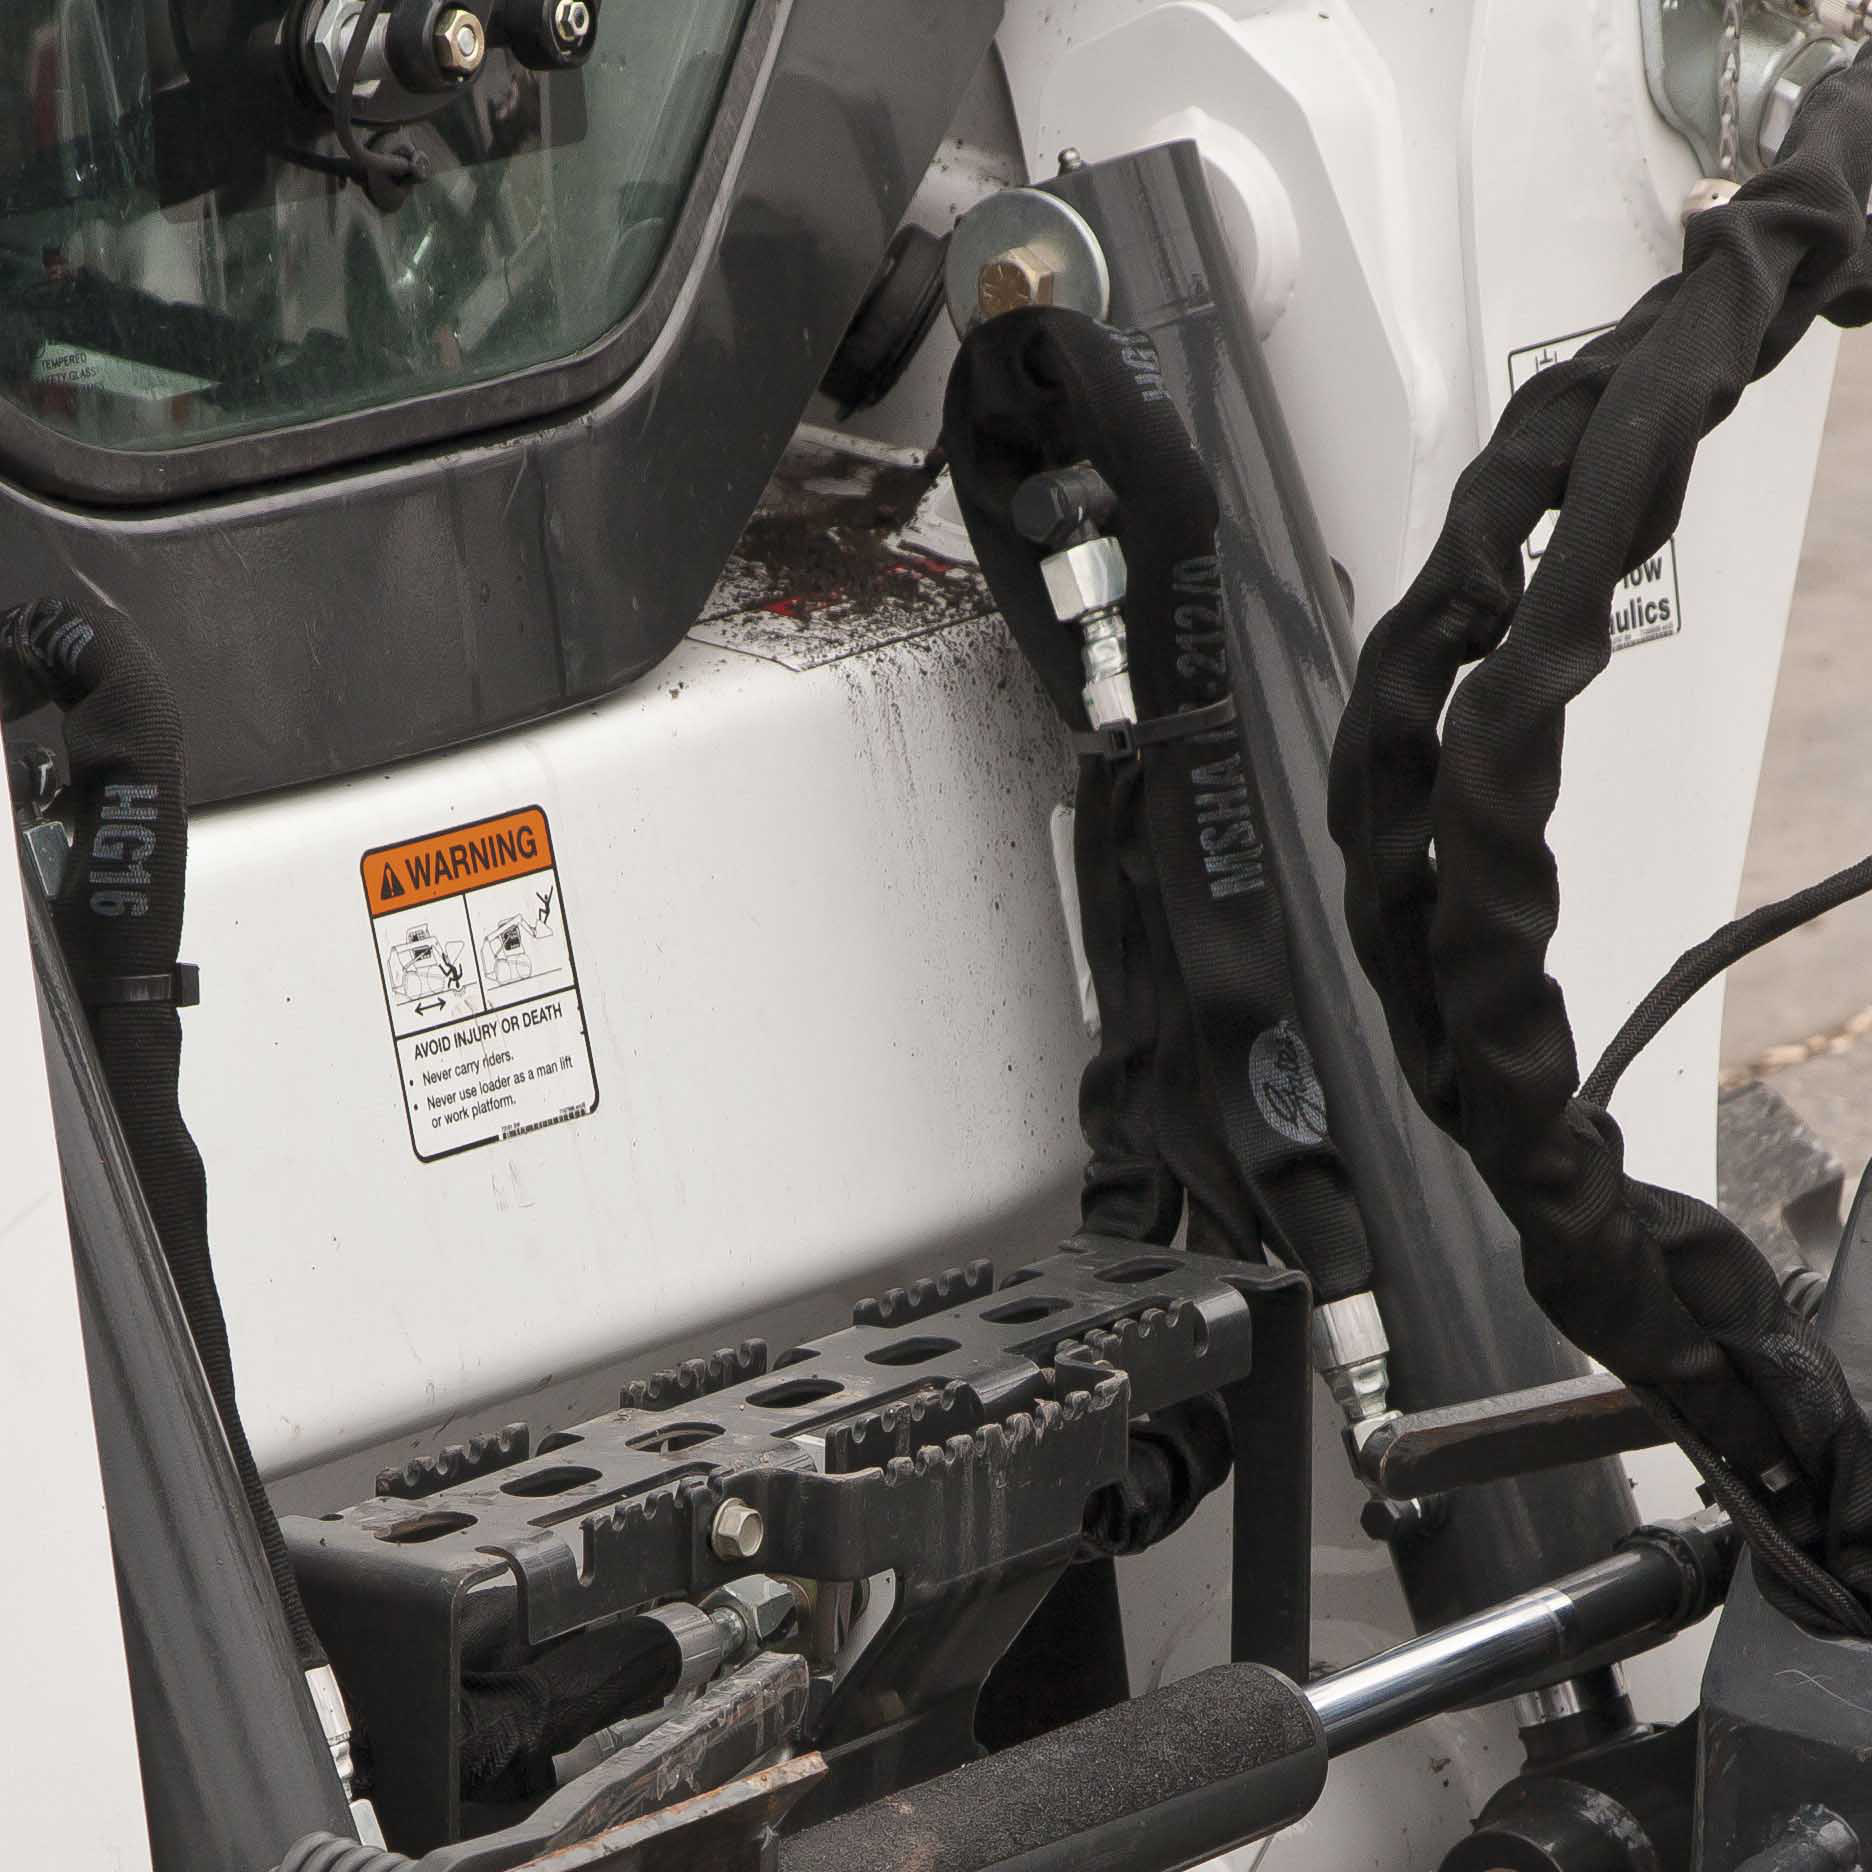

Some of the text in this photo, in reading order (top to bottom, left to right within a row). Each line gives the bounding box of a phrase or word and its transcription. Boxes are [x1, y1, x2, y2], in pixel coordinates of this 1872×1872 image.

[42, 353, 87, 369] TEMPERED
[69, 368, 96, 380] GLASS
[89, 784, 159, 917] HG16
[1191, 751, 1265, 898] MSHA
[405, 825, 537, 891] WARNING
[414, 1002, 563, 1061] AVOID INJURY OR DEATH
[422, 1050, 515, 1087] Never carry riders.
[426, 1055, 574, 1111] Never use loader as a man lift
[431, 1117, 442, 1129] or
[444, 1106, 469, 1126] work
[471, 1095, 517, 1120] platform.
